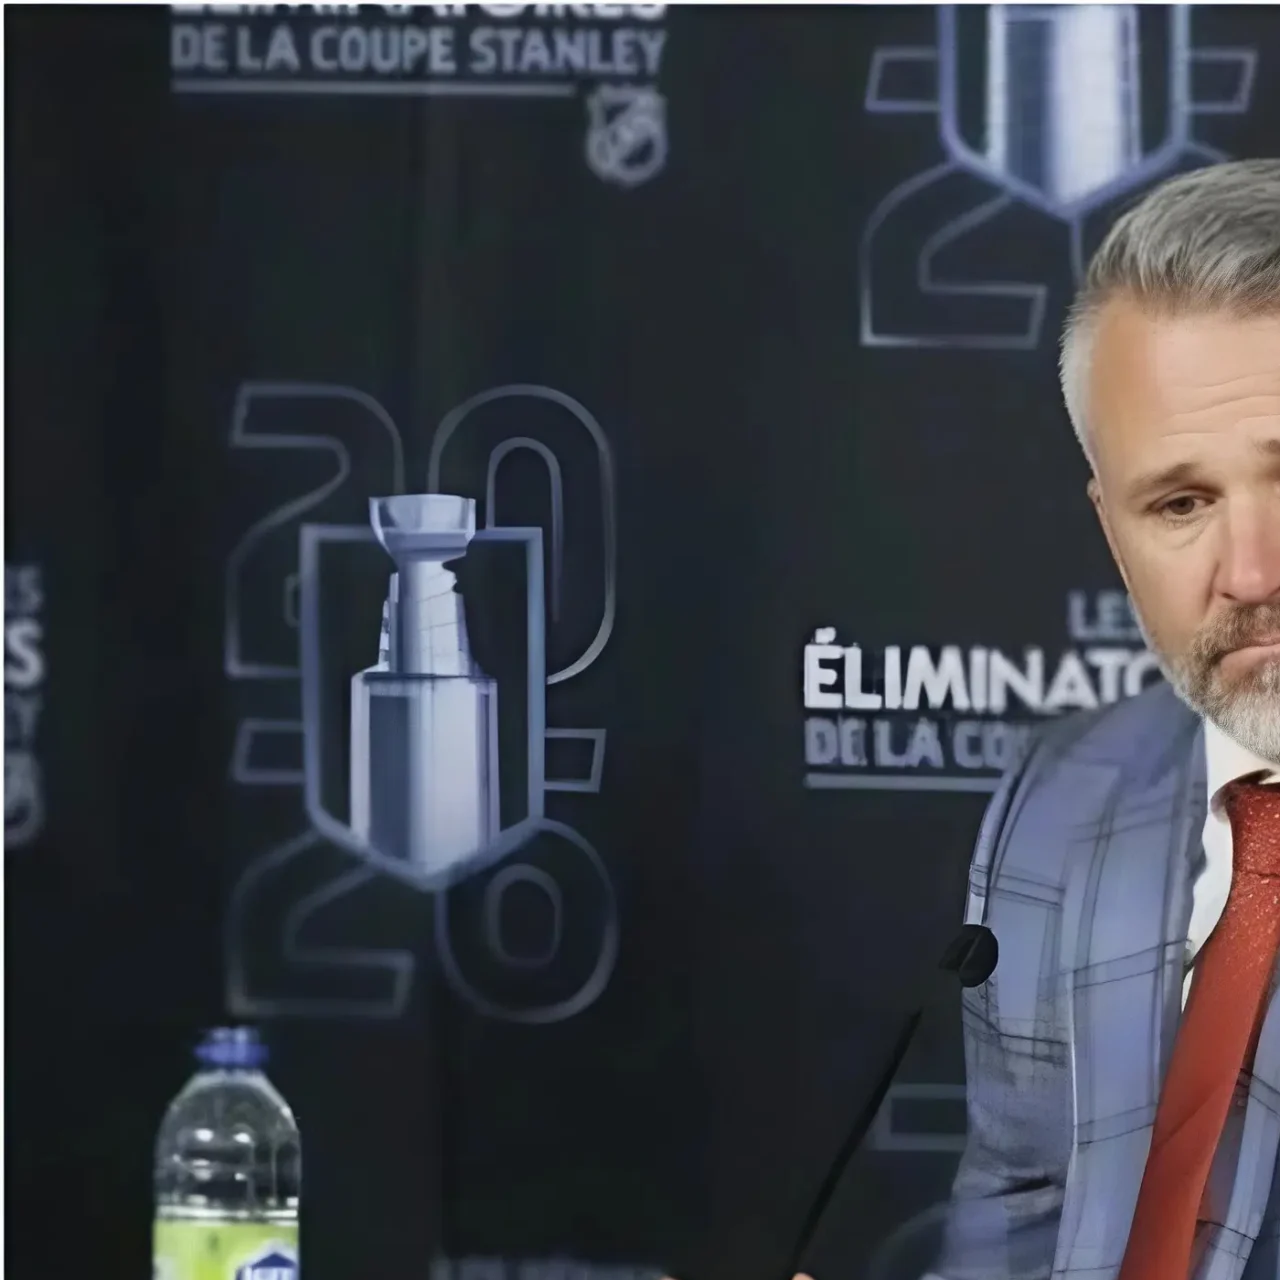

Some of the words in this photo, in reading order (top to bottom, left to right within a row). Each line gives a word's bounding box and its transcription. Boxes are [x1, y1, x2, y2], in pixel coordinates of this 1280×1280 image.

[171, 24, 228, 72] DE
[236, 26, 300, 73] LA
[309, 27, 457, 75] COUPE
[469, 29, 668, 76] STANLEY
[1068, 590, 1142, 642] LE
[874, 717, 945, 768] LA
